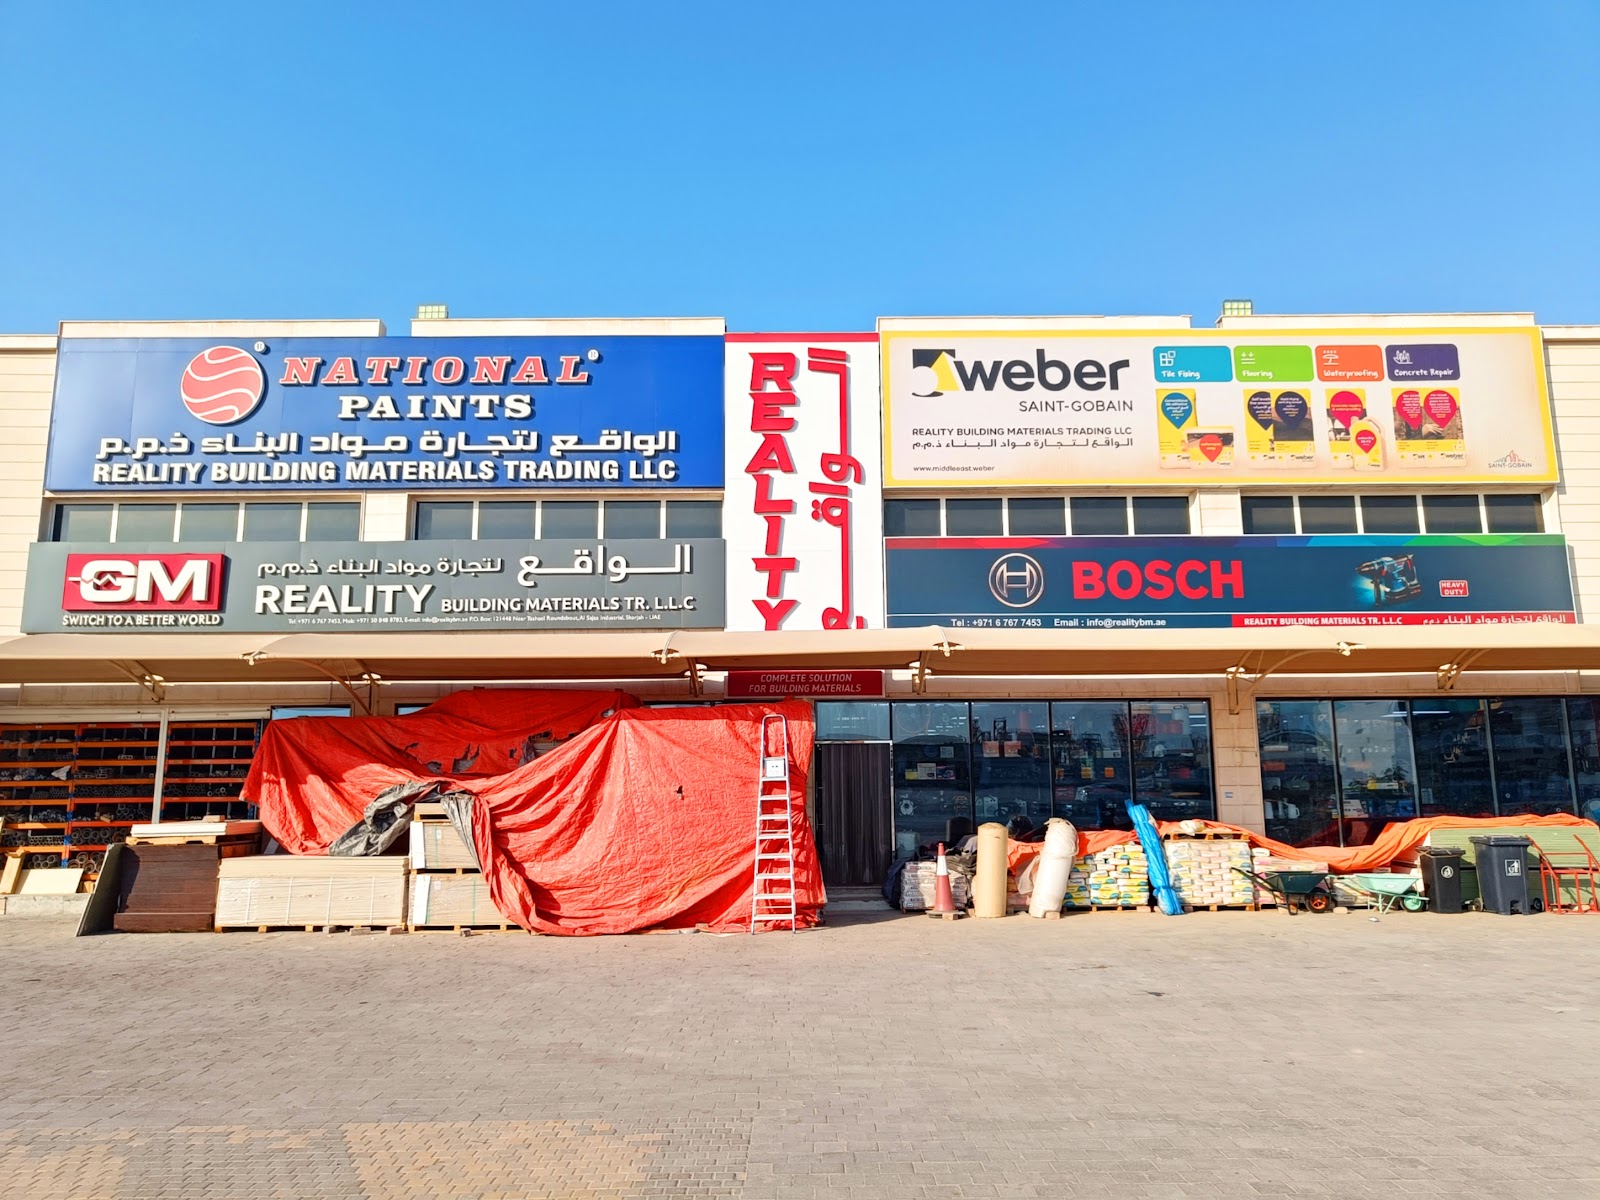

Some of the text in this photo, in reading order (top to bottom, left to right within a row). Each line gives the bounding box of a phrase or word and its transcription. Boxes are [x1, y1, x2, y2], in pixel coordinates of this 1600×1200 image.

[279, 355, 589, 385] NATIONAL
[953, 348, 1130, 392] weber
[1160, 369, 1201, 380] Tile Fixing
[1241, 369, 1274, 380] Flooring
[1323, 369, 1379, 380] Waterproofing
[1393, 368, 1454, 378] Concrete Repair
[337, 394, 532, 420] PAINTS
[1018, 400, 1134, 413] SAINT-GOBAIN
[912, 426, 1133, 436] REALITY BUILDING MATERIALS TRADING LLC
[309, 431, 408, 458] مواد
[418, 430, 539, 457] لتجارة
[1000, 439, 1031, 449] مواد
[1033, 437, 1089, 449] لتجارة
[93, 459, 677, 483] REALITY BUILDING MATERIALS TRADING LLC
[913, 464, 995, 472] www.middleeast.weber
[744, 351, 799, 631] REALITY
[326, 558, 379, 578] البناء
[384, 558, 431, 576] مواد
[436, 557, 503, 576] لتجارة
[76, 559, 209, 603] GM
[1071, 559, 1245, 600] BOSCH
[254, 583, 695, 614] REALITY BUILDING MATERIALS TR. L.L.C
[62, 613, 221, 626] SWITCH TO A BETTER WORLD
[972, 619, 993, 627] +971
[1020, 618, 1042, 626] 7453
[1054, 618, 1079, 626] Email
[1086, 618, 1166, 628] info@realitybm.ae
[1244, 617, 1278, 626] REALITY
[1279, 617, 1319, 625] BUILDING
[1321, 617, 1366, 625] MATERIALS
[1367, 616, 1381, 625] TR.
[760, 673, 853, 683] COMPLETE SOLUTION
[749, 683, 862, 693] FOR BUILDING MATERIALS
